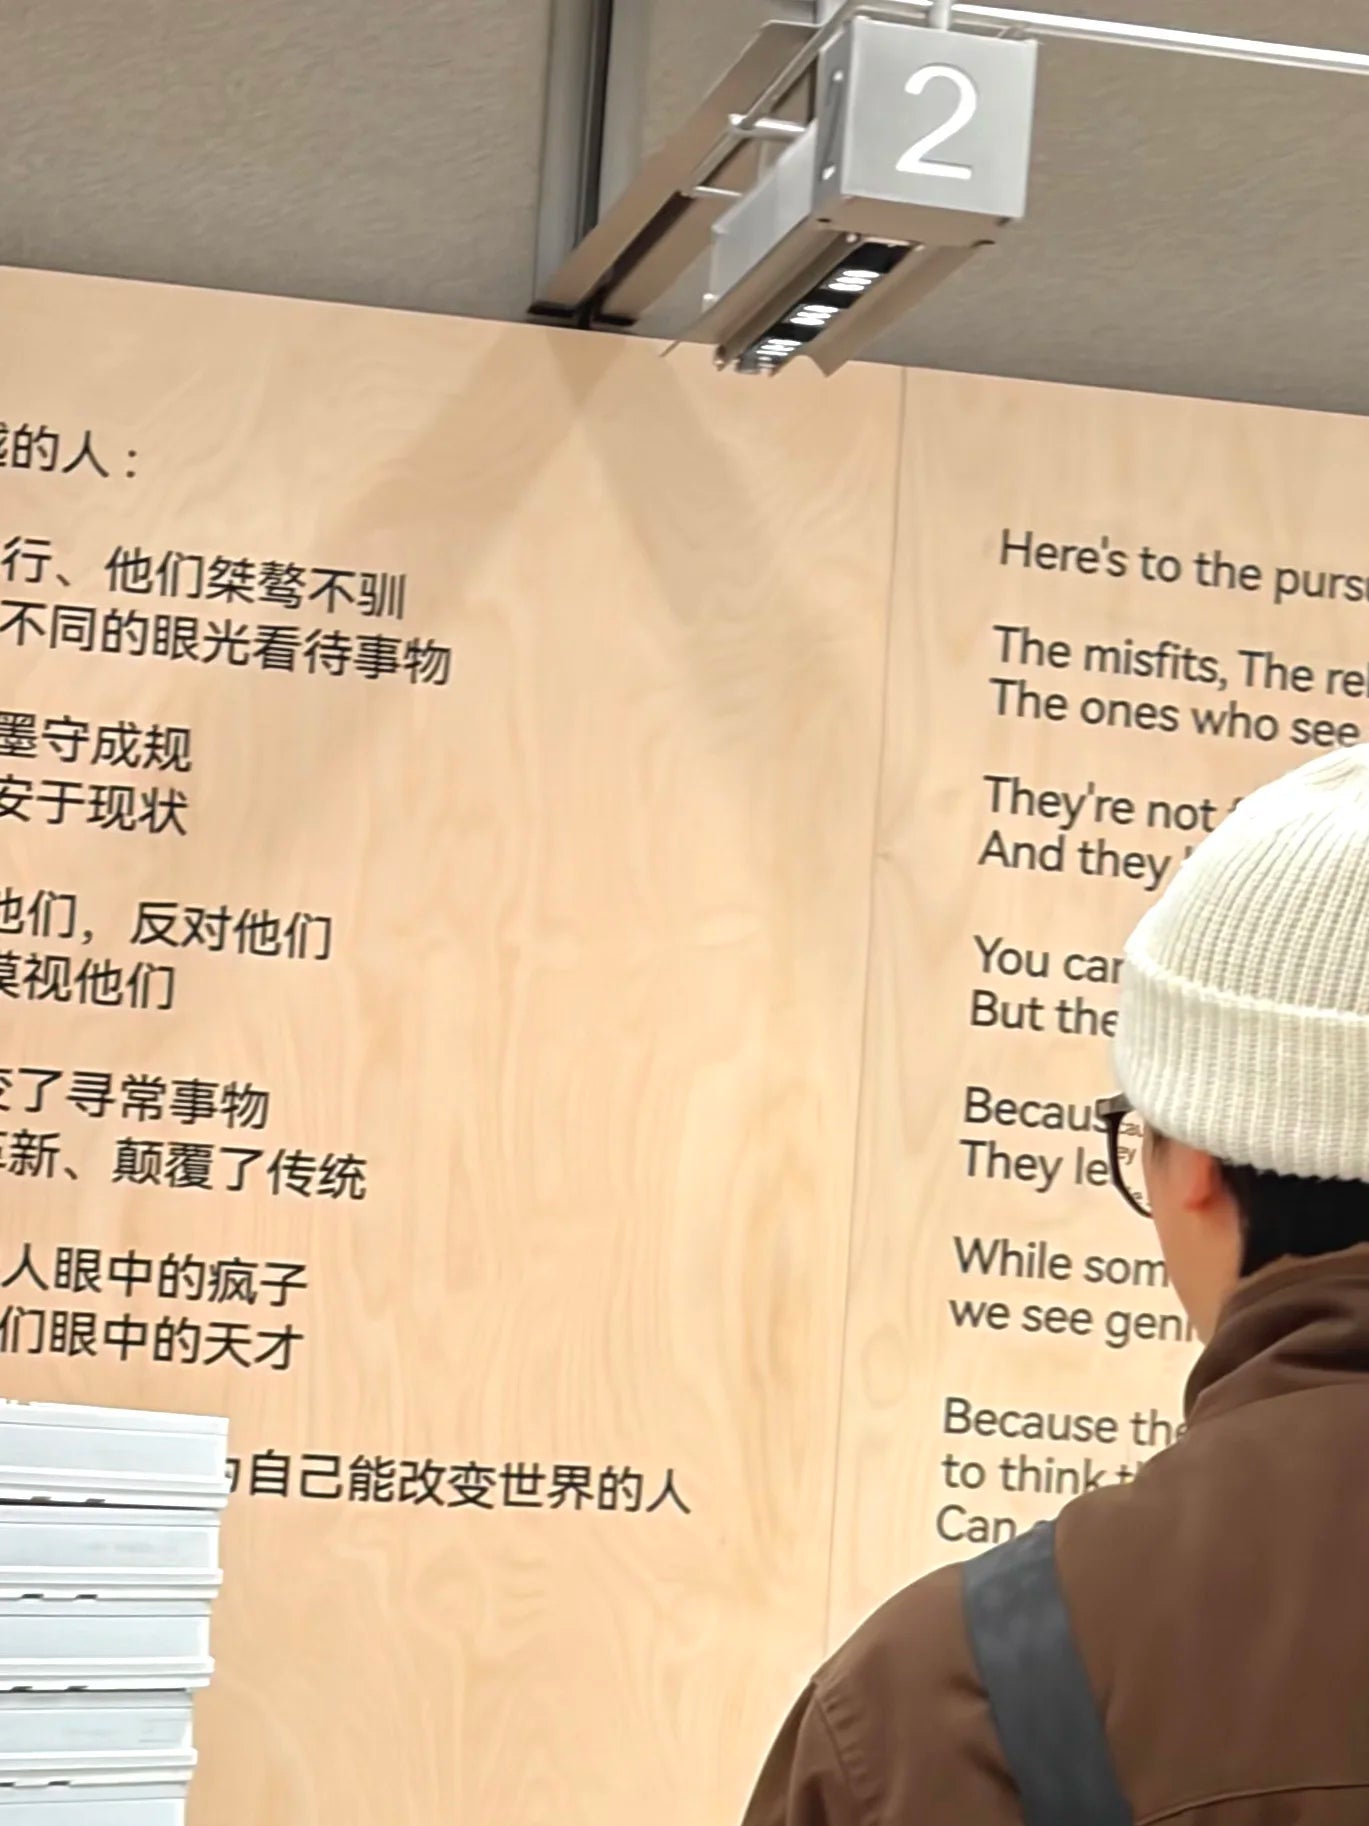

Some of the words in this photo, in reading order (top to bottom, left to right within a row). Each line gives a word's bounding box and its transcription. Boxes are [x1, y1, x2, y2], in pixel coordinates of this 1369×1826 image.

[895, 63, 978, 181] 2
[0, 420, 137, 479] 的人：
[999, 527, 1129, 578] Here's
[1139, 545, 1182, 583] to
[1192, 549, 1263, 592] the
[0, 601, 452, 686] 不同的眼光看待事物
[993, 624, 1073, 670] The
[1082, 638, 1228, 692] misfits,
[1237, 649, 1315, 694] The
[0, 710, 193, 773] 墨守成规
[989, 677, 1069, 722] The
[1079, 695, 1181, 733] ones
[1191, 700, 1280, 743] who
[1289, 717, 1361, 748] see
[0, 773, 190, 837] 安于现状
[983, 774, 1136, 830] They're
[1146, 798, 1220, 834] not
[977, 829, 1067, 873] And
[1077, 838, 1173, 893] they
[973, 934, 1051, 979] You
[969, 988, 1045, 1033] But
[0, 1066, 271, 1131] 了寻常事物
[963, 1085, 1109, 1135] Becau
[959, 1138, 1065, 1194] They
[1074, 1146, 1113, 1188] le
[0, 1242, 309, 1308] 人眼中的疯子
[952, 1235, 1074, 1282] While
[1083, 1255, 1169, 1288] som
[0, 1305, 305, 1371] 们眼中的天才
[948, 1299, 1011, 1330] we
[1021, 1303, 1094, 1336] see
[1104, 1310, 1193, 1349] gen
[943, 1395, 1119, 1444] Because
[941, 1453, 986, 1489] to
[998, 1453, 1108, 1495] think
[936, 1504, 1018, 1545] Can
